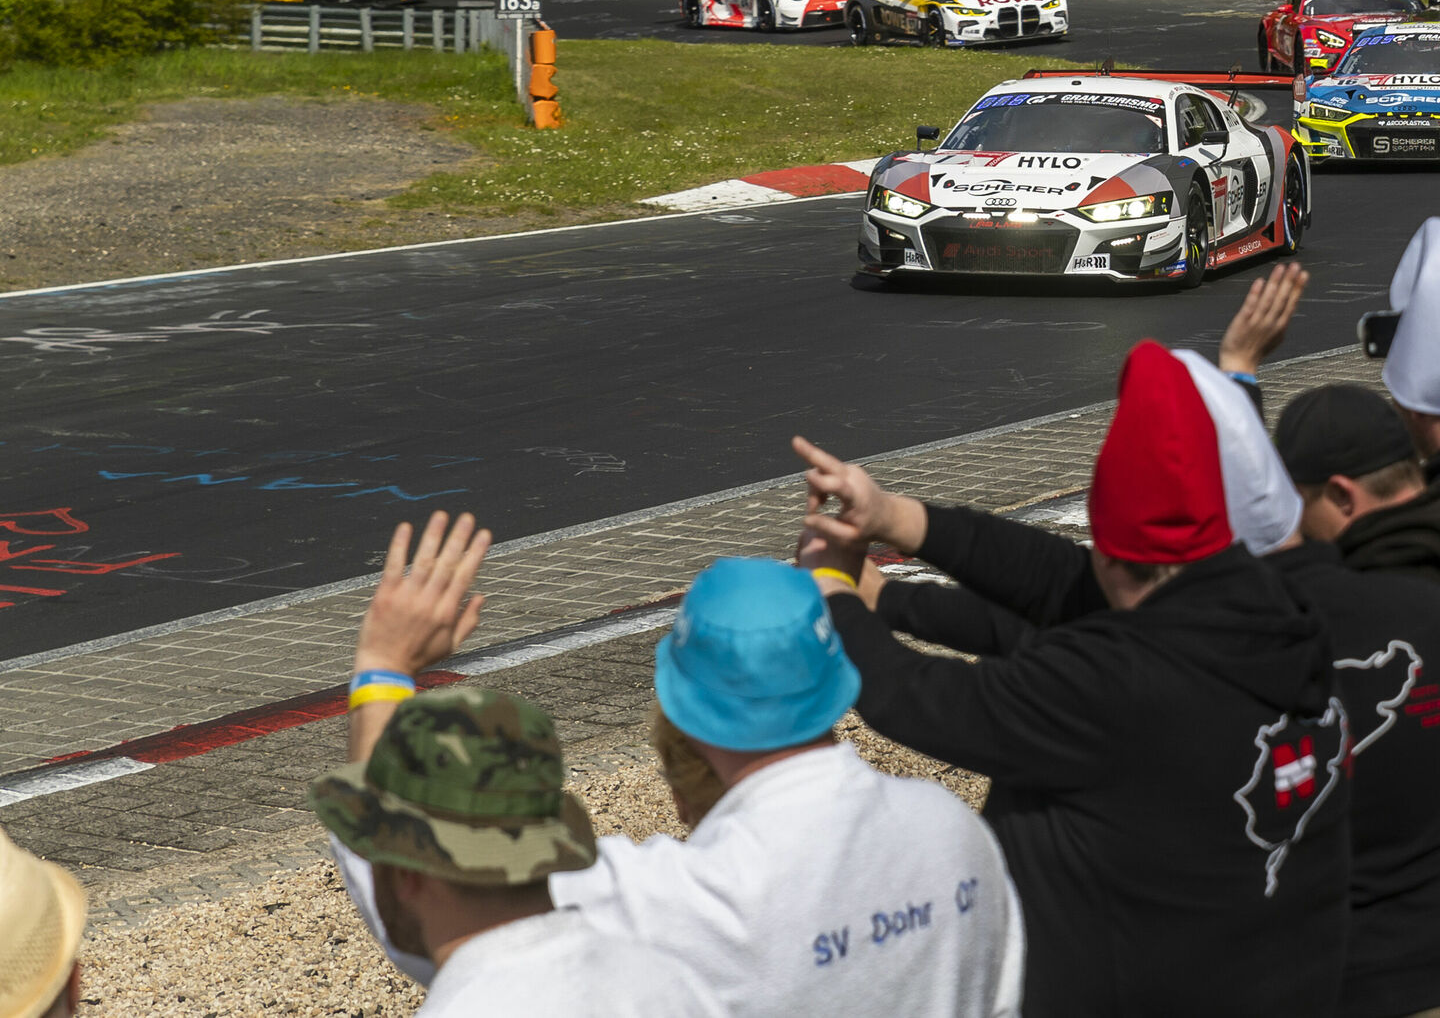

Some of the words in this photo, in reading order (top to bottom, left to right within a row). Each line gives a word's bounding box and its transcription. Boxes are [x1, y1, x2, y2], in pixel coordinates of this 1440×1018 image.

[1061, 94, 1099, 102] GRAN
[1100, 95, 1160, 110] TURISMO
[1018, 156, 1082, 169] HYLO
[952, 183, 1064, 196] SCHERER
[962, 244, 1001, 257] Audi
[1005, 245, 1054, 261] Sport
[1074, 256, 1093, 269] H&R
[813, 926, 849, 966] SV
[871, 900, 933, 944] Dohr
